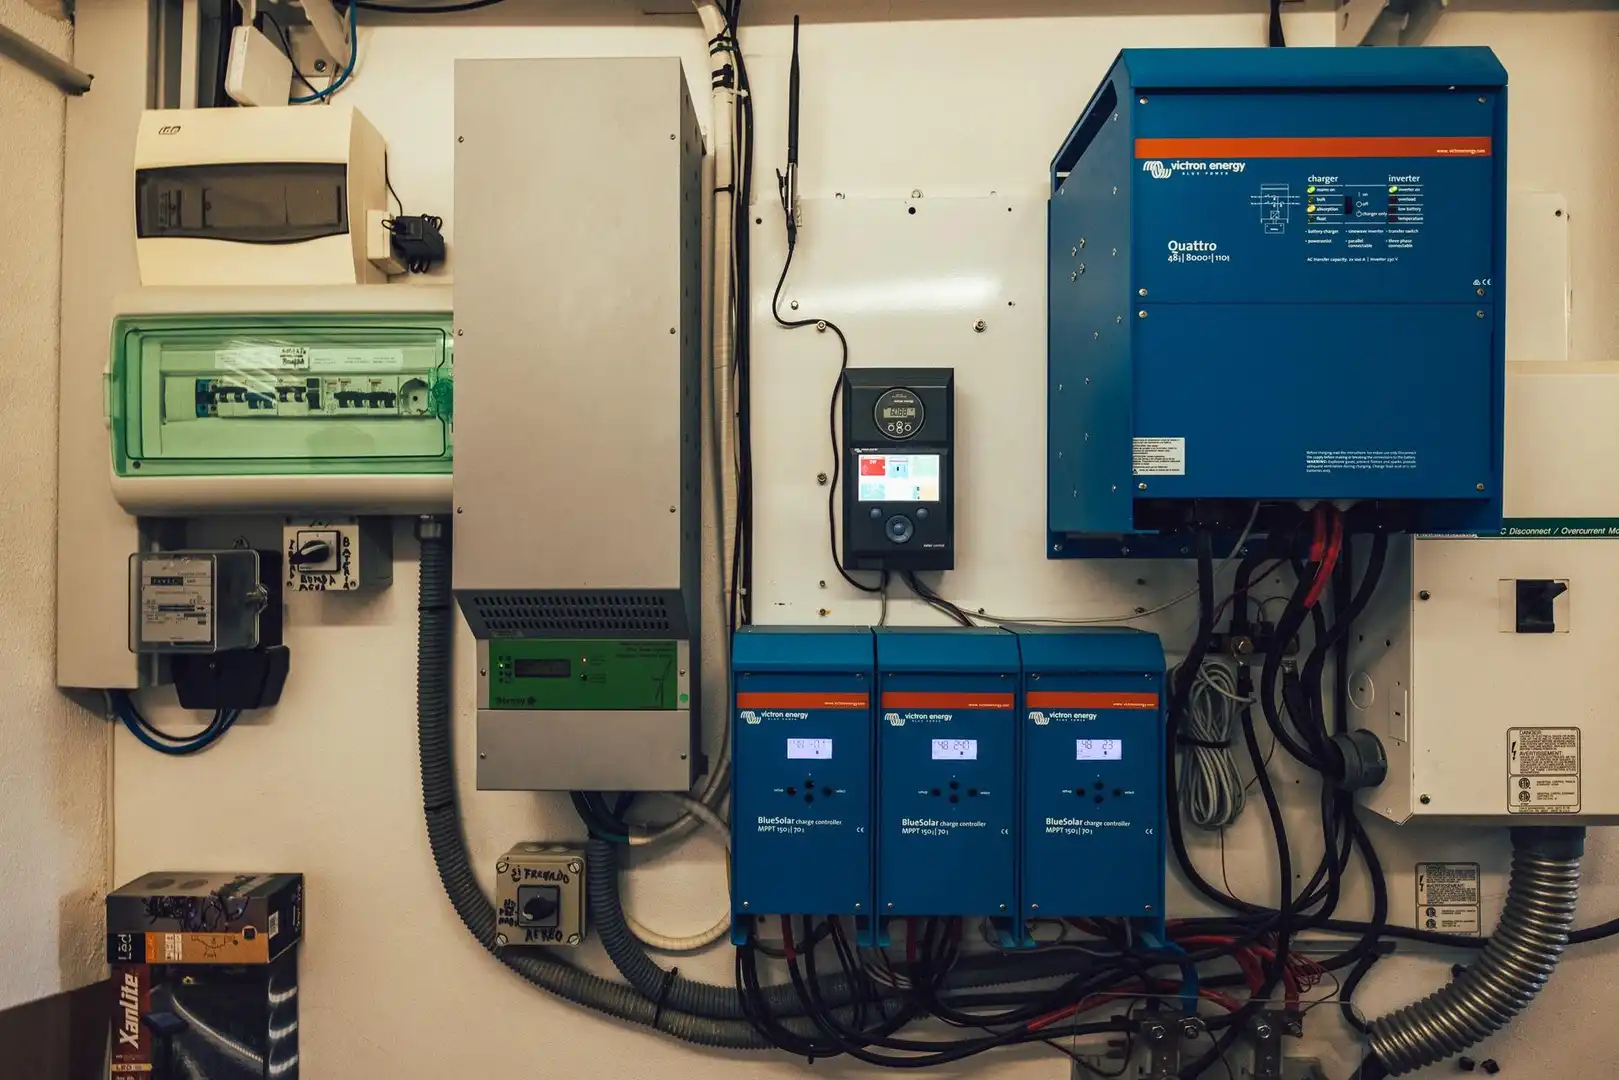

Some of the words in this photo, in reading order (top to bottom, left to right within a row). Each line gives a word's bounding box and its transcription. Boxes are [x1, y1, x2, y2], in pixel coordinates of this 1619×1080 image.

[1171, 160, 1206, 171] victron
[1209, 162, 1246, 172] energy
[1307, 175, 1339, 185] charger
[1388, 174, 1421, 183] inverter
[1167, 240, 1217, 253] Quattro
[1561, 527, 1606, 535] Overcurrent
[1074, 713, 1097, 721] energy
[758, 817, 795, 825] BlueSolar
[902, 819, 939, 827] BlueSolar
[1046, 818, 1083, 826] BlueSolar
[118, 972, 139, 1050] XanLite
